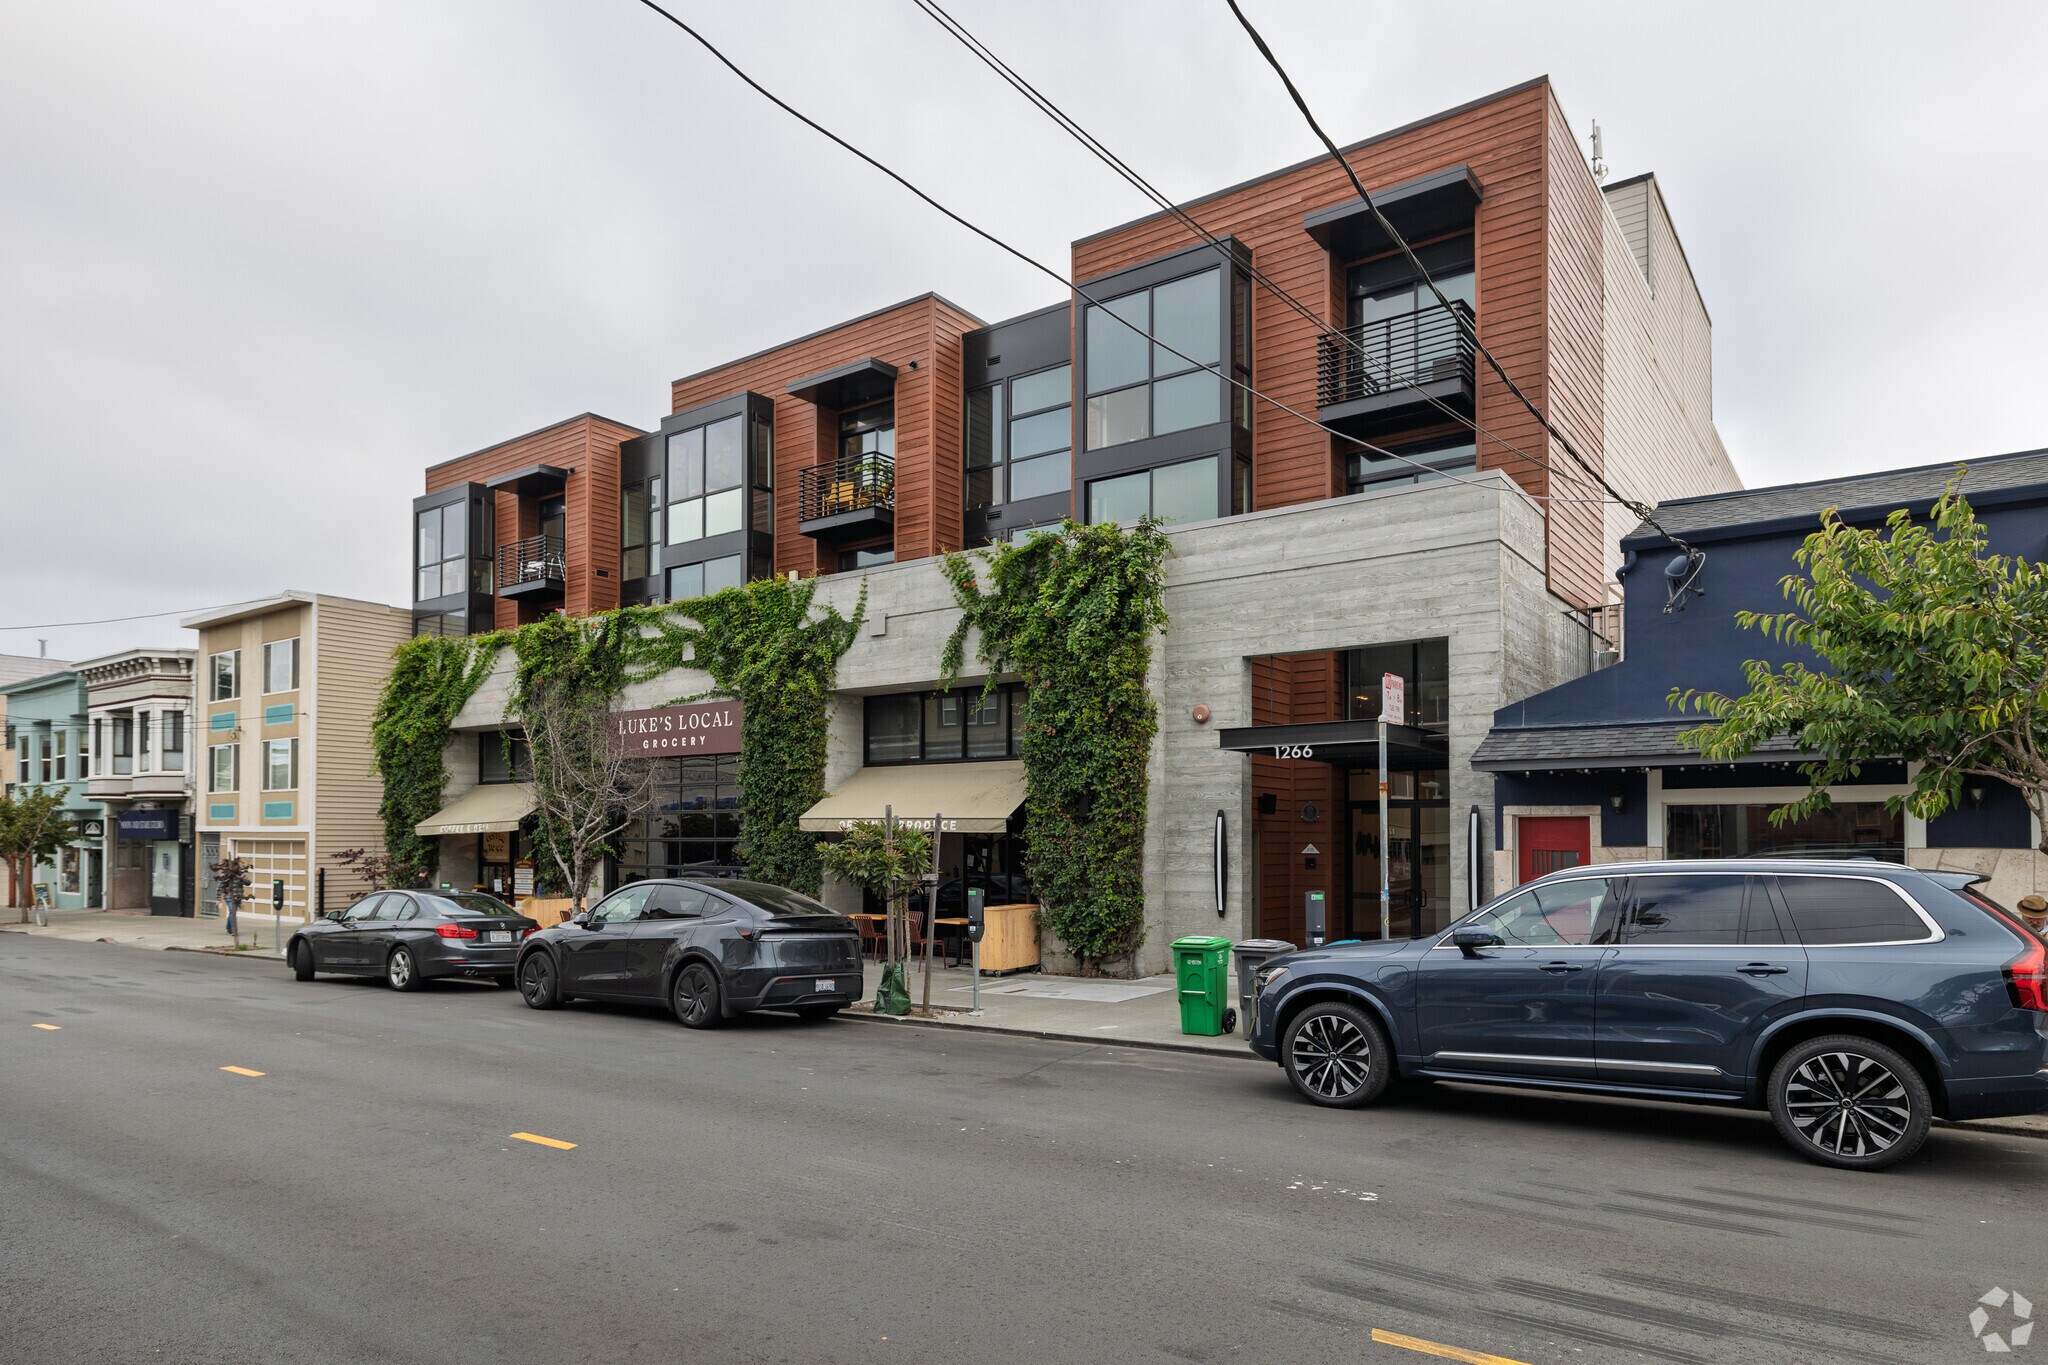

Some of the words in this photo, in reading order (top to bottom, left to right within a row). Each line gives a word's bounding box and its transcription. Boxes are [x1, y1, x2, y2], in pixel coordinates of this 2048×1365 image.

[618, 715, 673, 735] LUKE'S
[678, 710, 733, 730] LOCAL
[642, 735, 706, 749] GROCERY
[1274, 744, 1314, 760] 1266
